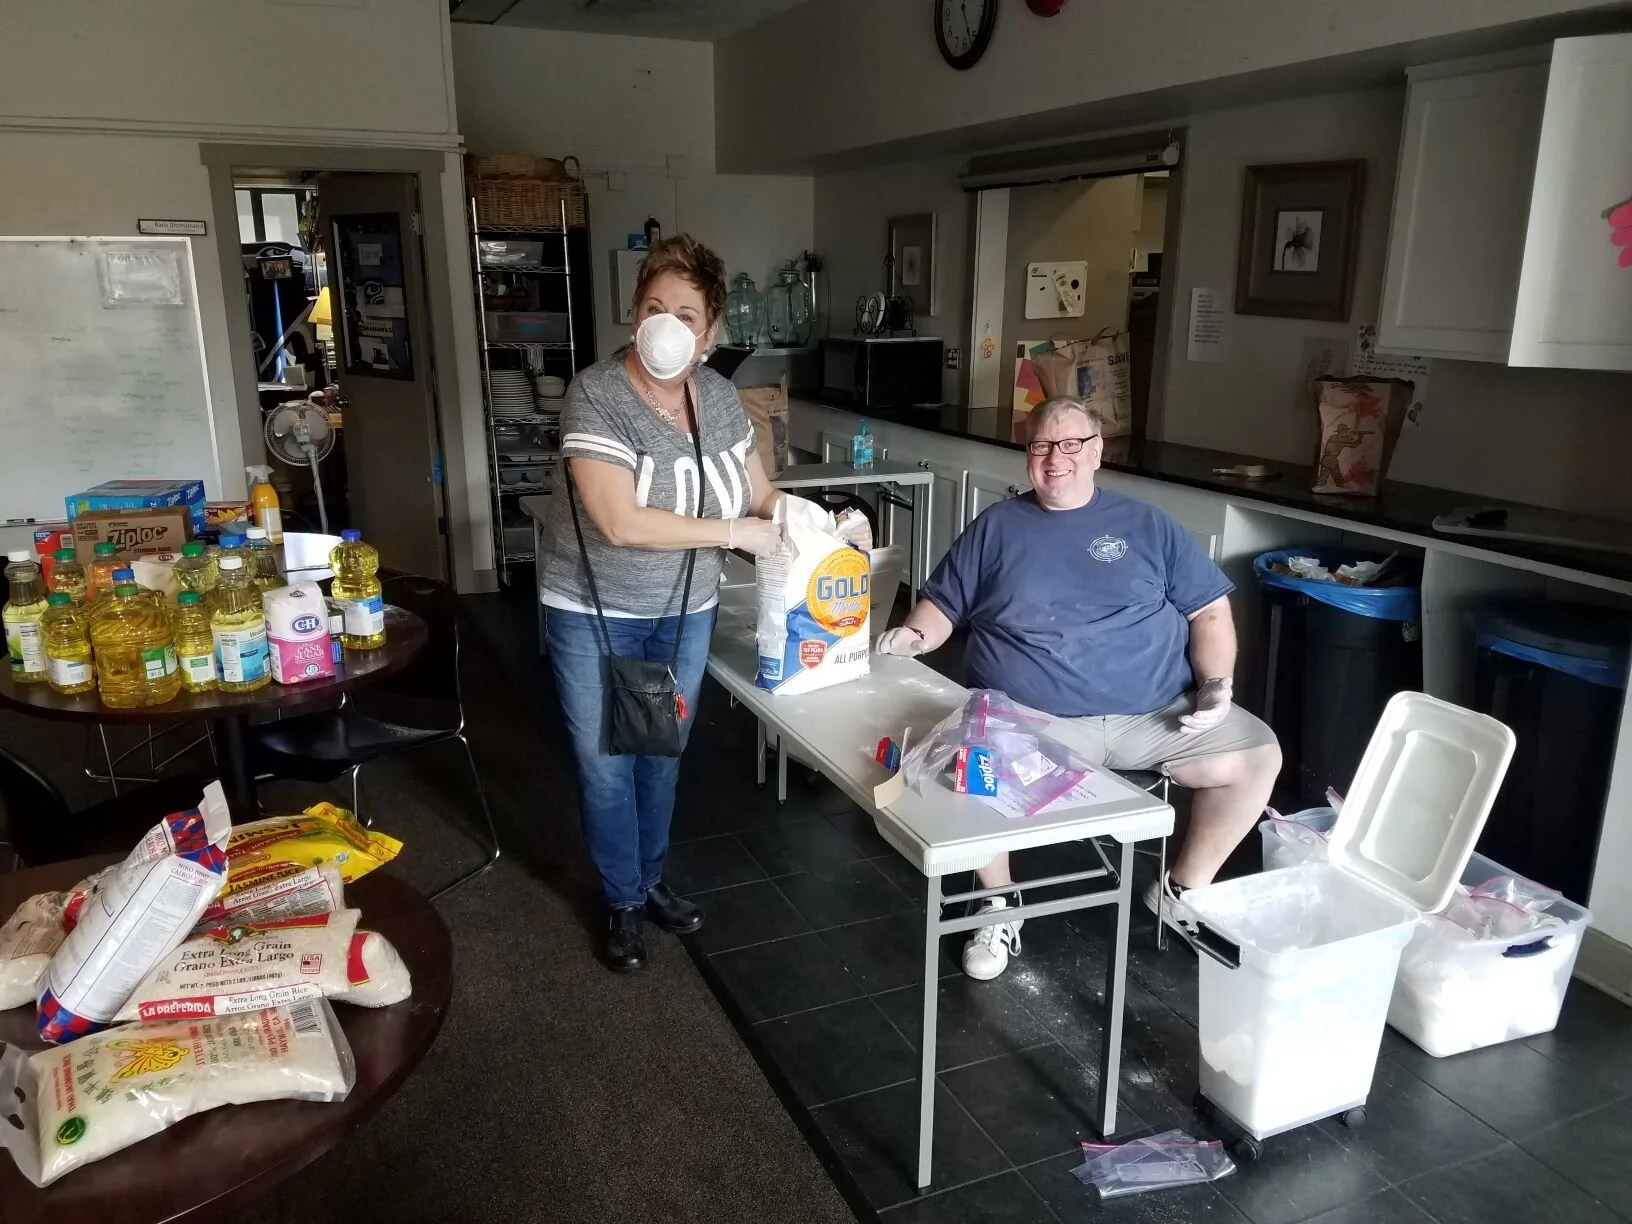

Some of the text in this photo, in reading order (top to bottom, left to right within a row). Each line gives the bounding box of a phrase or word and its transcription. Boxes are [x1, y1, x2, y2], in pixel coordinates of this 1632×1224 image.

[107, 526, 164, 551] Ziploc
[816, 573, 869, 601] GOLD
[294, 617, 317, 631] C&H
[294, 649, 325, 660] SUGAR
[297, 644, 321, 654] CANE
[834, 653, 847, 665] ALL
[228, 873, 277, 893] JASMINE
[181, 950, 214, 961] Extra
[253, 941, 292, 952] Grain
[303, 953, 320, 961] USA
[174, 961, 216, 973] Grano
[257, 951, 295, 964] Largo
[228, 986, 308, 1005] Extra Long Grain Rice
[142, 1007, 156, 1017] LA
[246, 1001, 270, 1010] Grano
